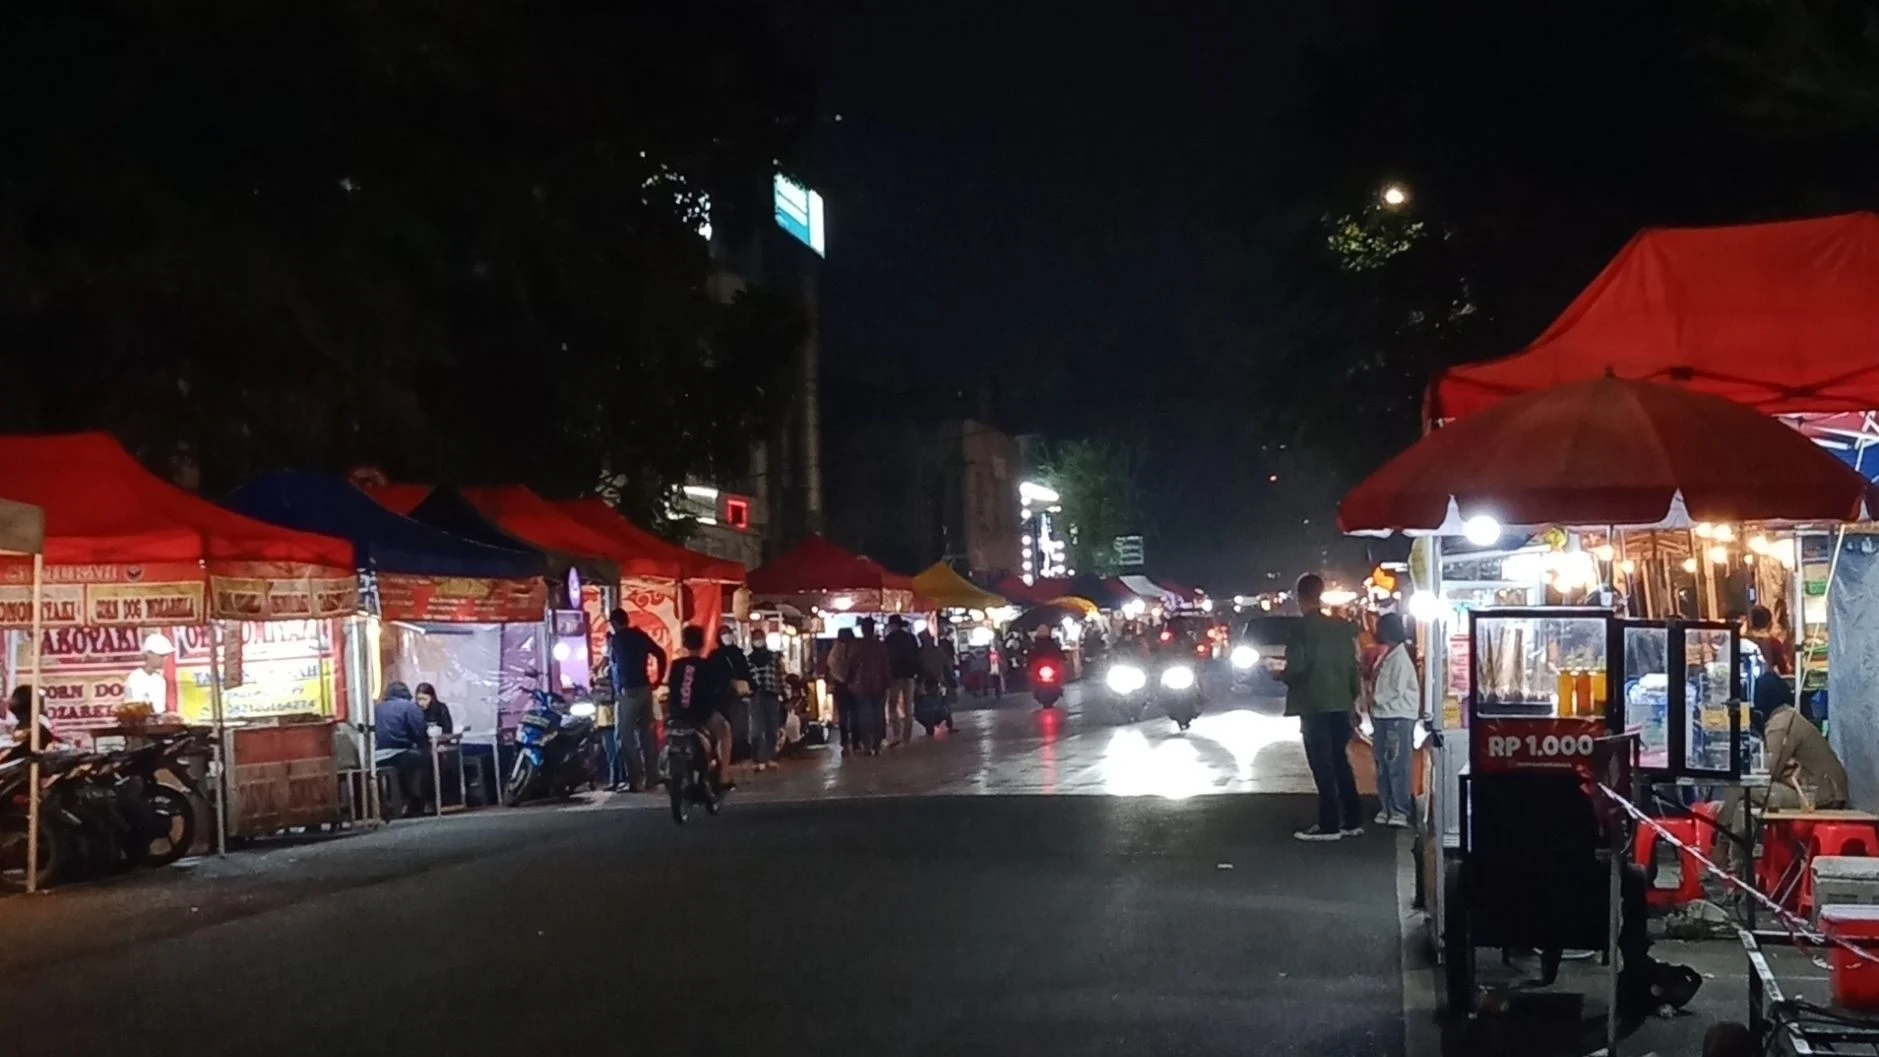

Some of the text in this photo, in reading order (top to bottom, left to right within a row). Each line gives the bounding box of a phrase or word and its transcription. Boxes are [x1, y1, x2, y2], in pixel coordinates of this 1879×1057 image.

[28, 625, 140, 653] AKOYAKI
[40, 683, 125, 699] ORN DO
[1488, 735, 1593, 757] RP 1.000
